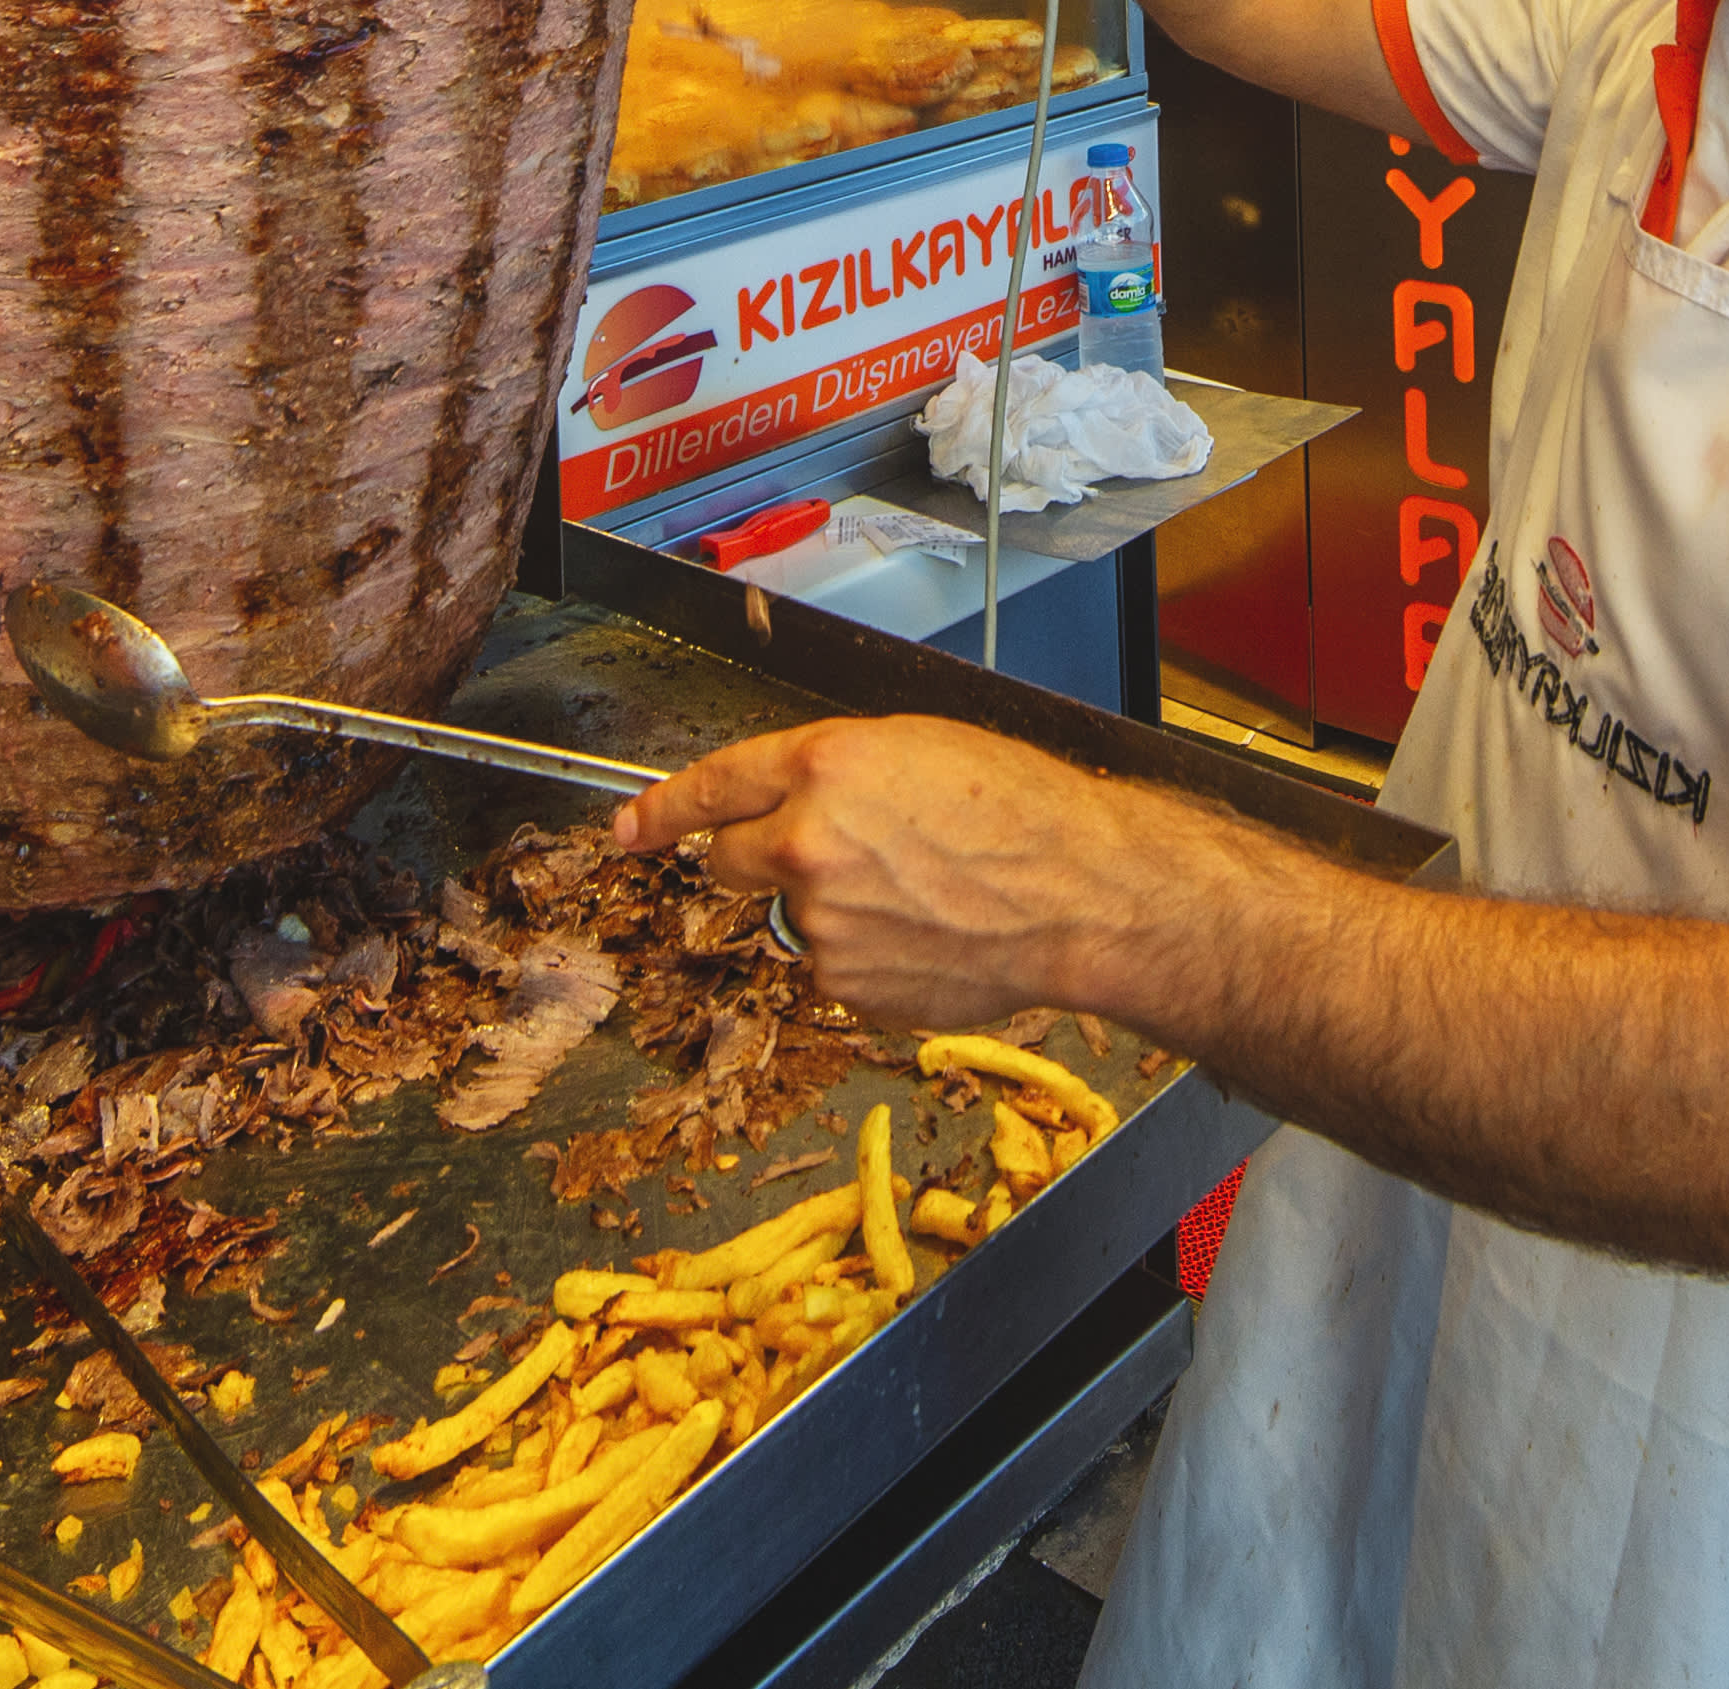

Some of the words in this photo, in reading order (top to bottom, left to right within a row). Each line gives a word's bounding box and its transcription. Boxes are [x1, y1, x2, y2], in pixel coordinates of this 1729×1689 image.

[1109, 285, 1146, 300] damla
[603, 392, 798, 494] Dillerden
[812, 314, 1004, 413] Düşmeyen
[1018, 287, 1080, 333] Lez
